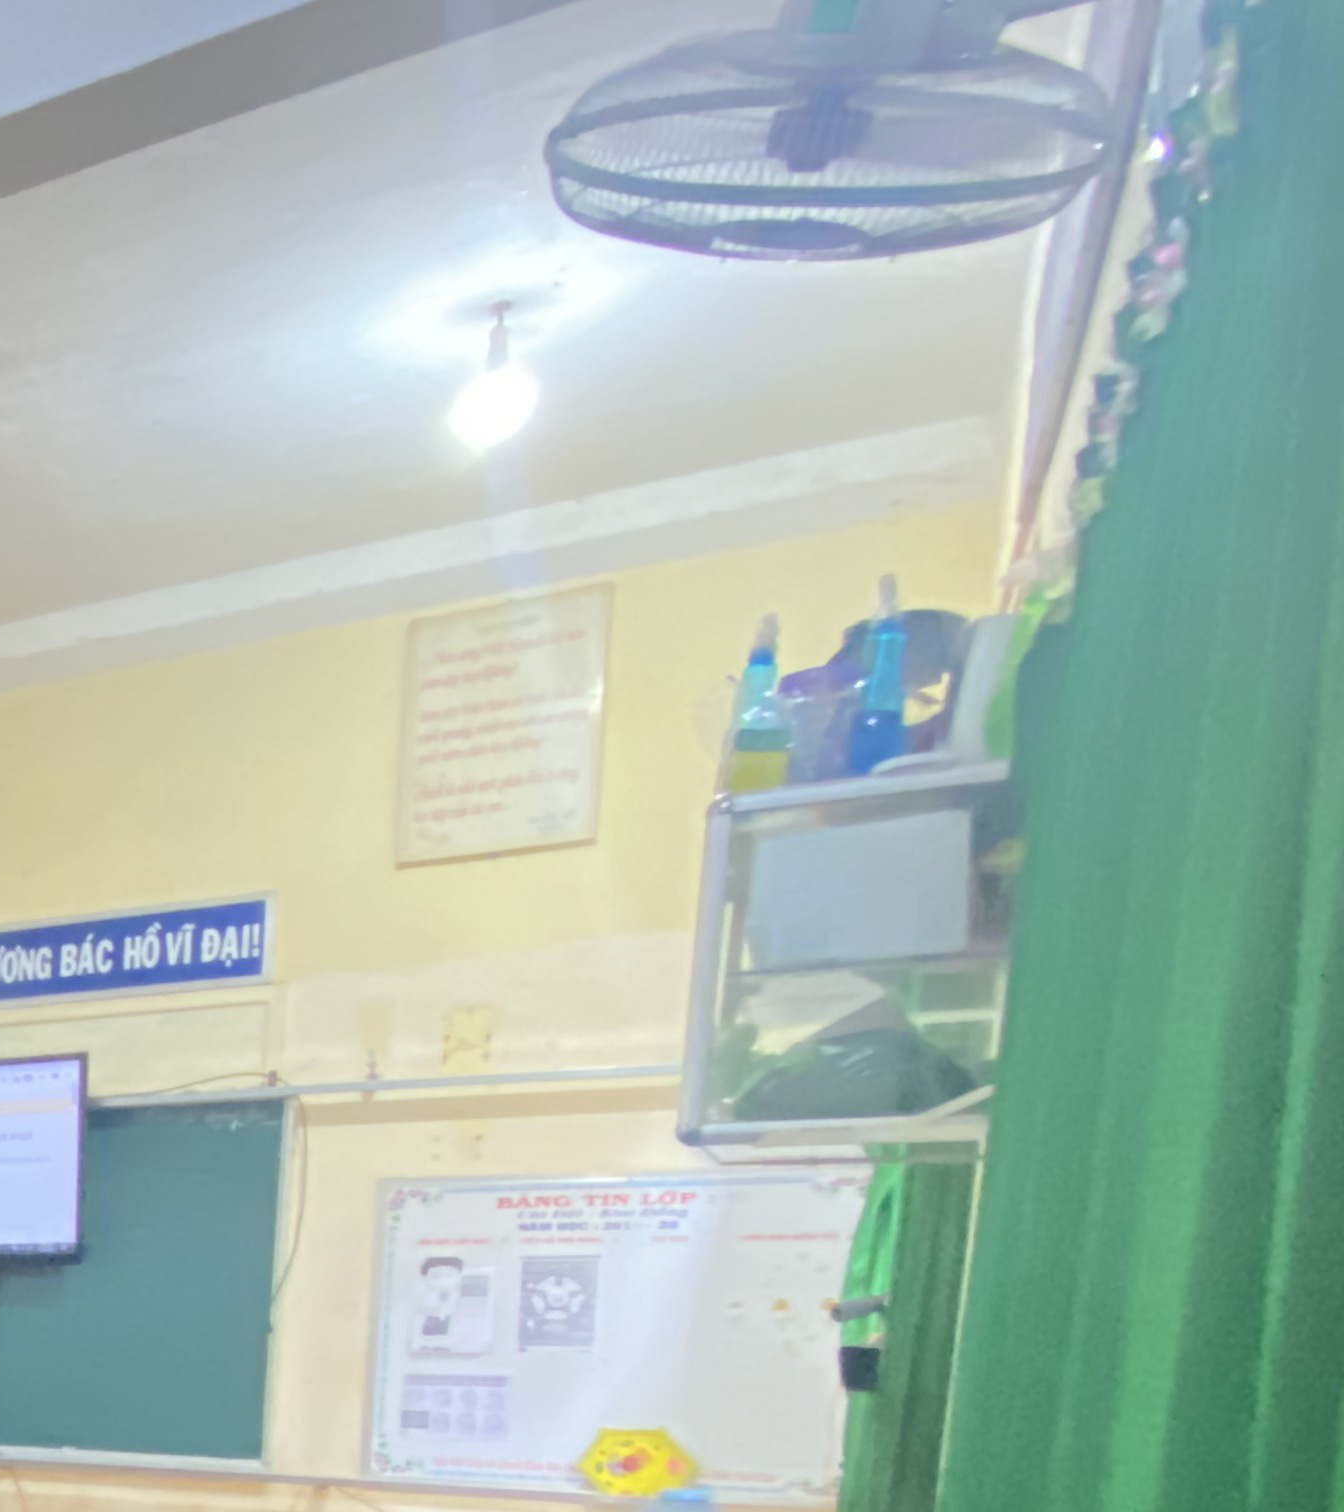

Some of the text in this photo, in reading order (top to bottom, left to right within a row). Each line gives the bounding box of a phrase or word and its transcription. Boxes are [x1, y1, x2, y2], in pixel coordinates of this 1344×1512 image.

[59, 932, 114, 978] BÁC
[123, 921, 162, 970] HỒ
[164, 922, 195, 967] VĨ
[199, 922, 261, 968] ĐẠI!
[496, 1190, 698, 1210] BẢNG TIN LỚP
